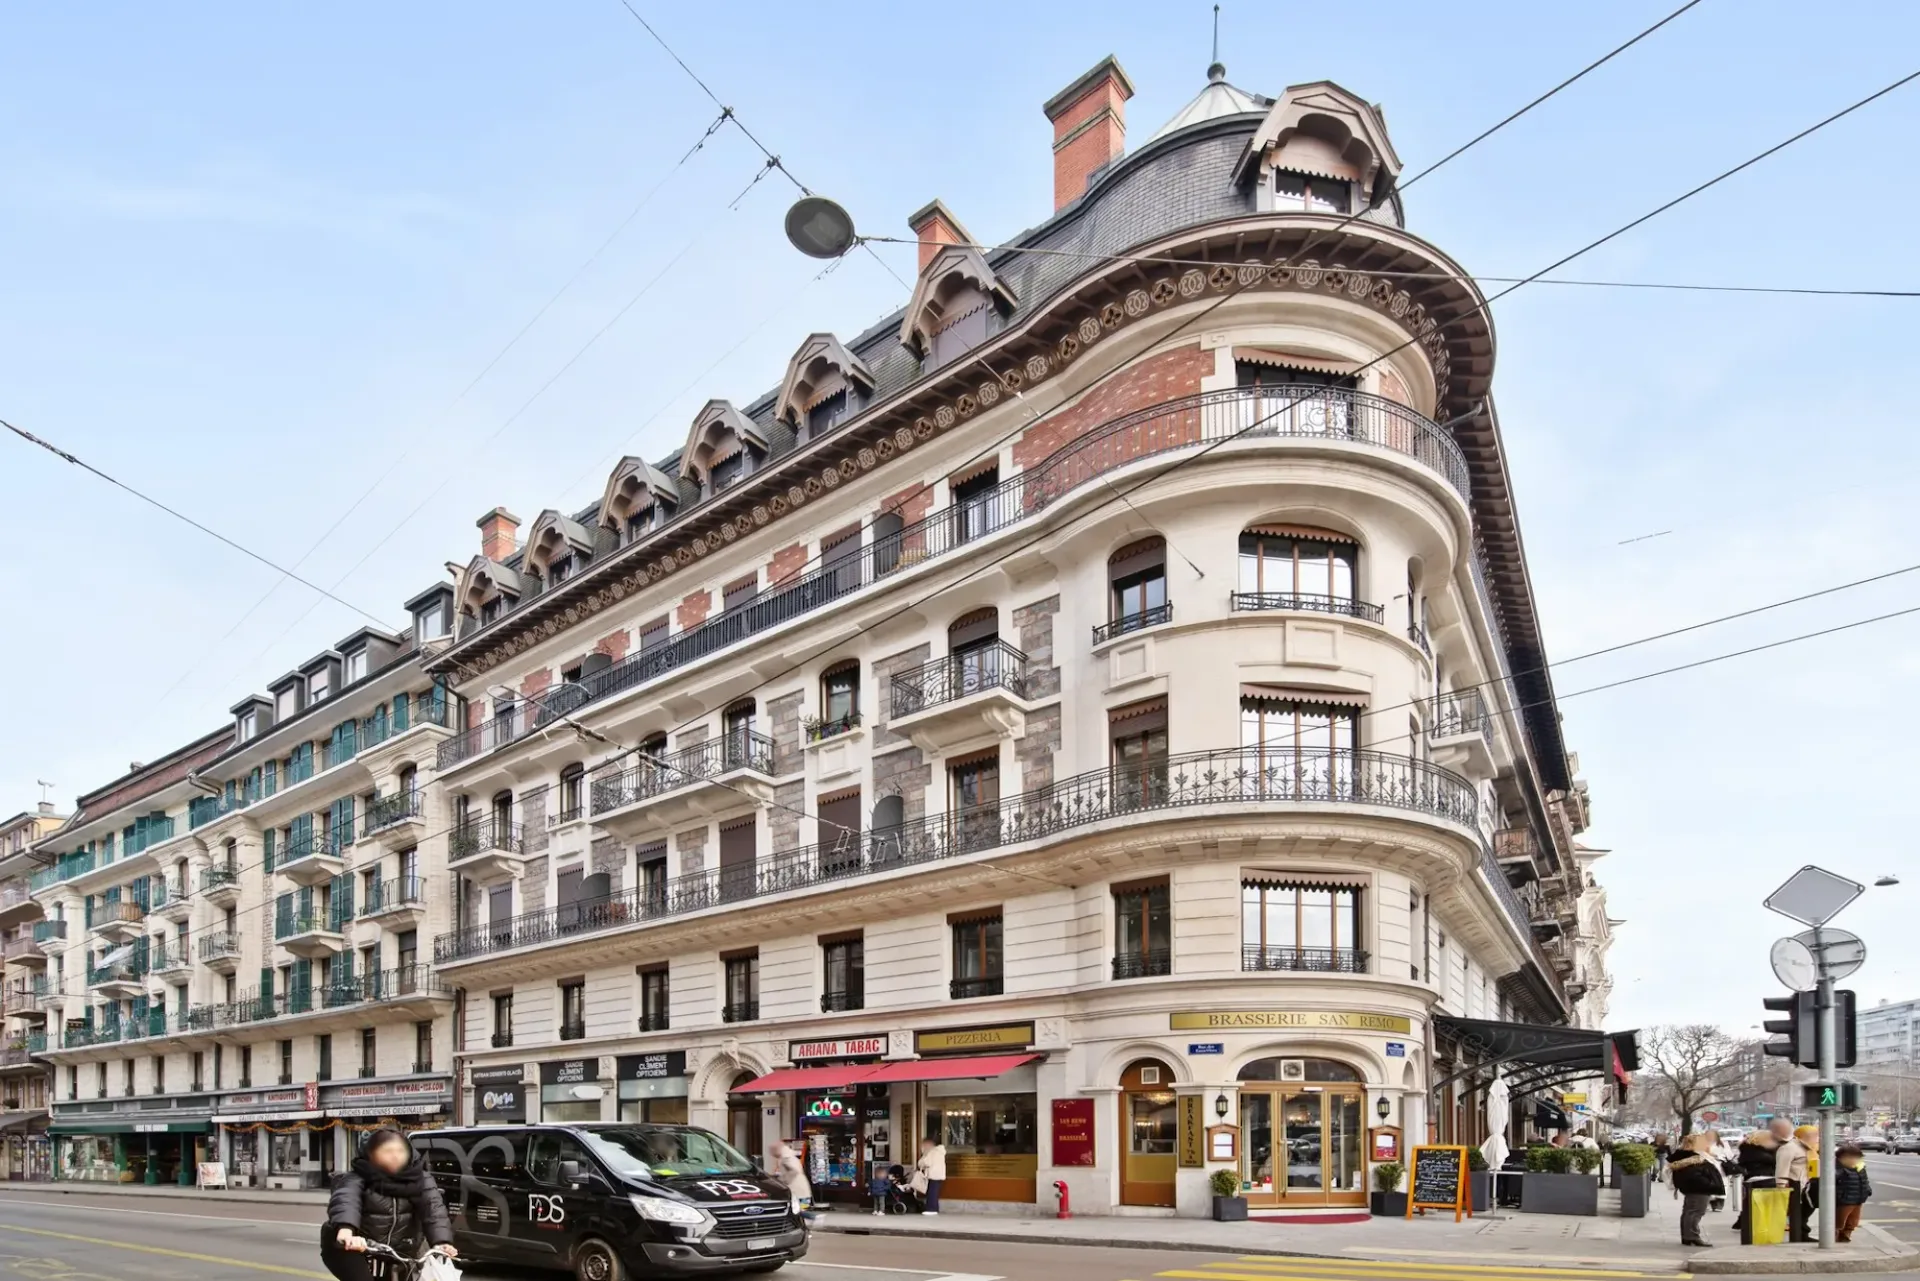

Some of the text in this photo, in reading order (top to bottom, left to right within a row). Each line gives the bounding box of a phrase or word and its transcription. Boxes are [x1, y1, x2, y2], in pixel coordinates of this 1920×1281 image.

[1208, 1013, 1394, 1029] BRASSERIE SAN REMO
[945, 1031, 1002, 1045] PIZZERIA
[798, 1039, 880, 1057] ARIANA TABAC
[644, 1054, 668, 1062] SANDIE
[696, 1179, 761, 1196] FDS
[528, 1193, 565, 1223] FDS
